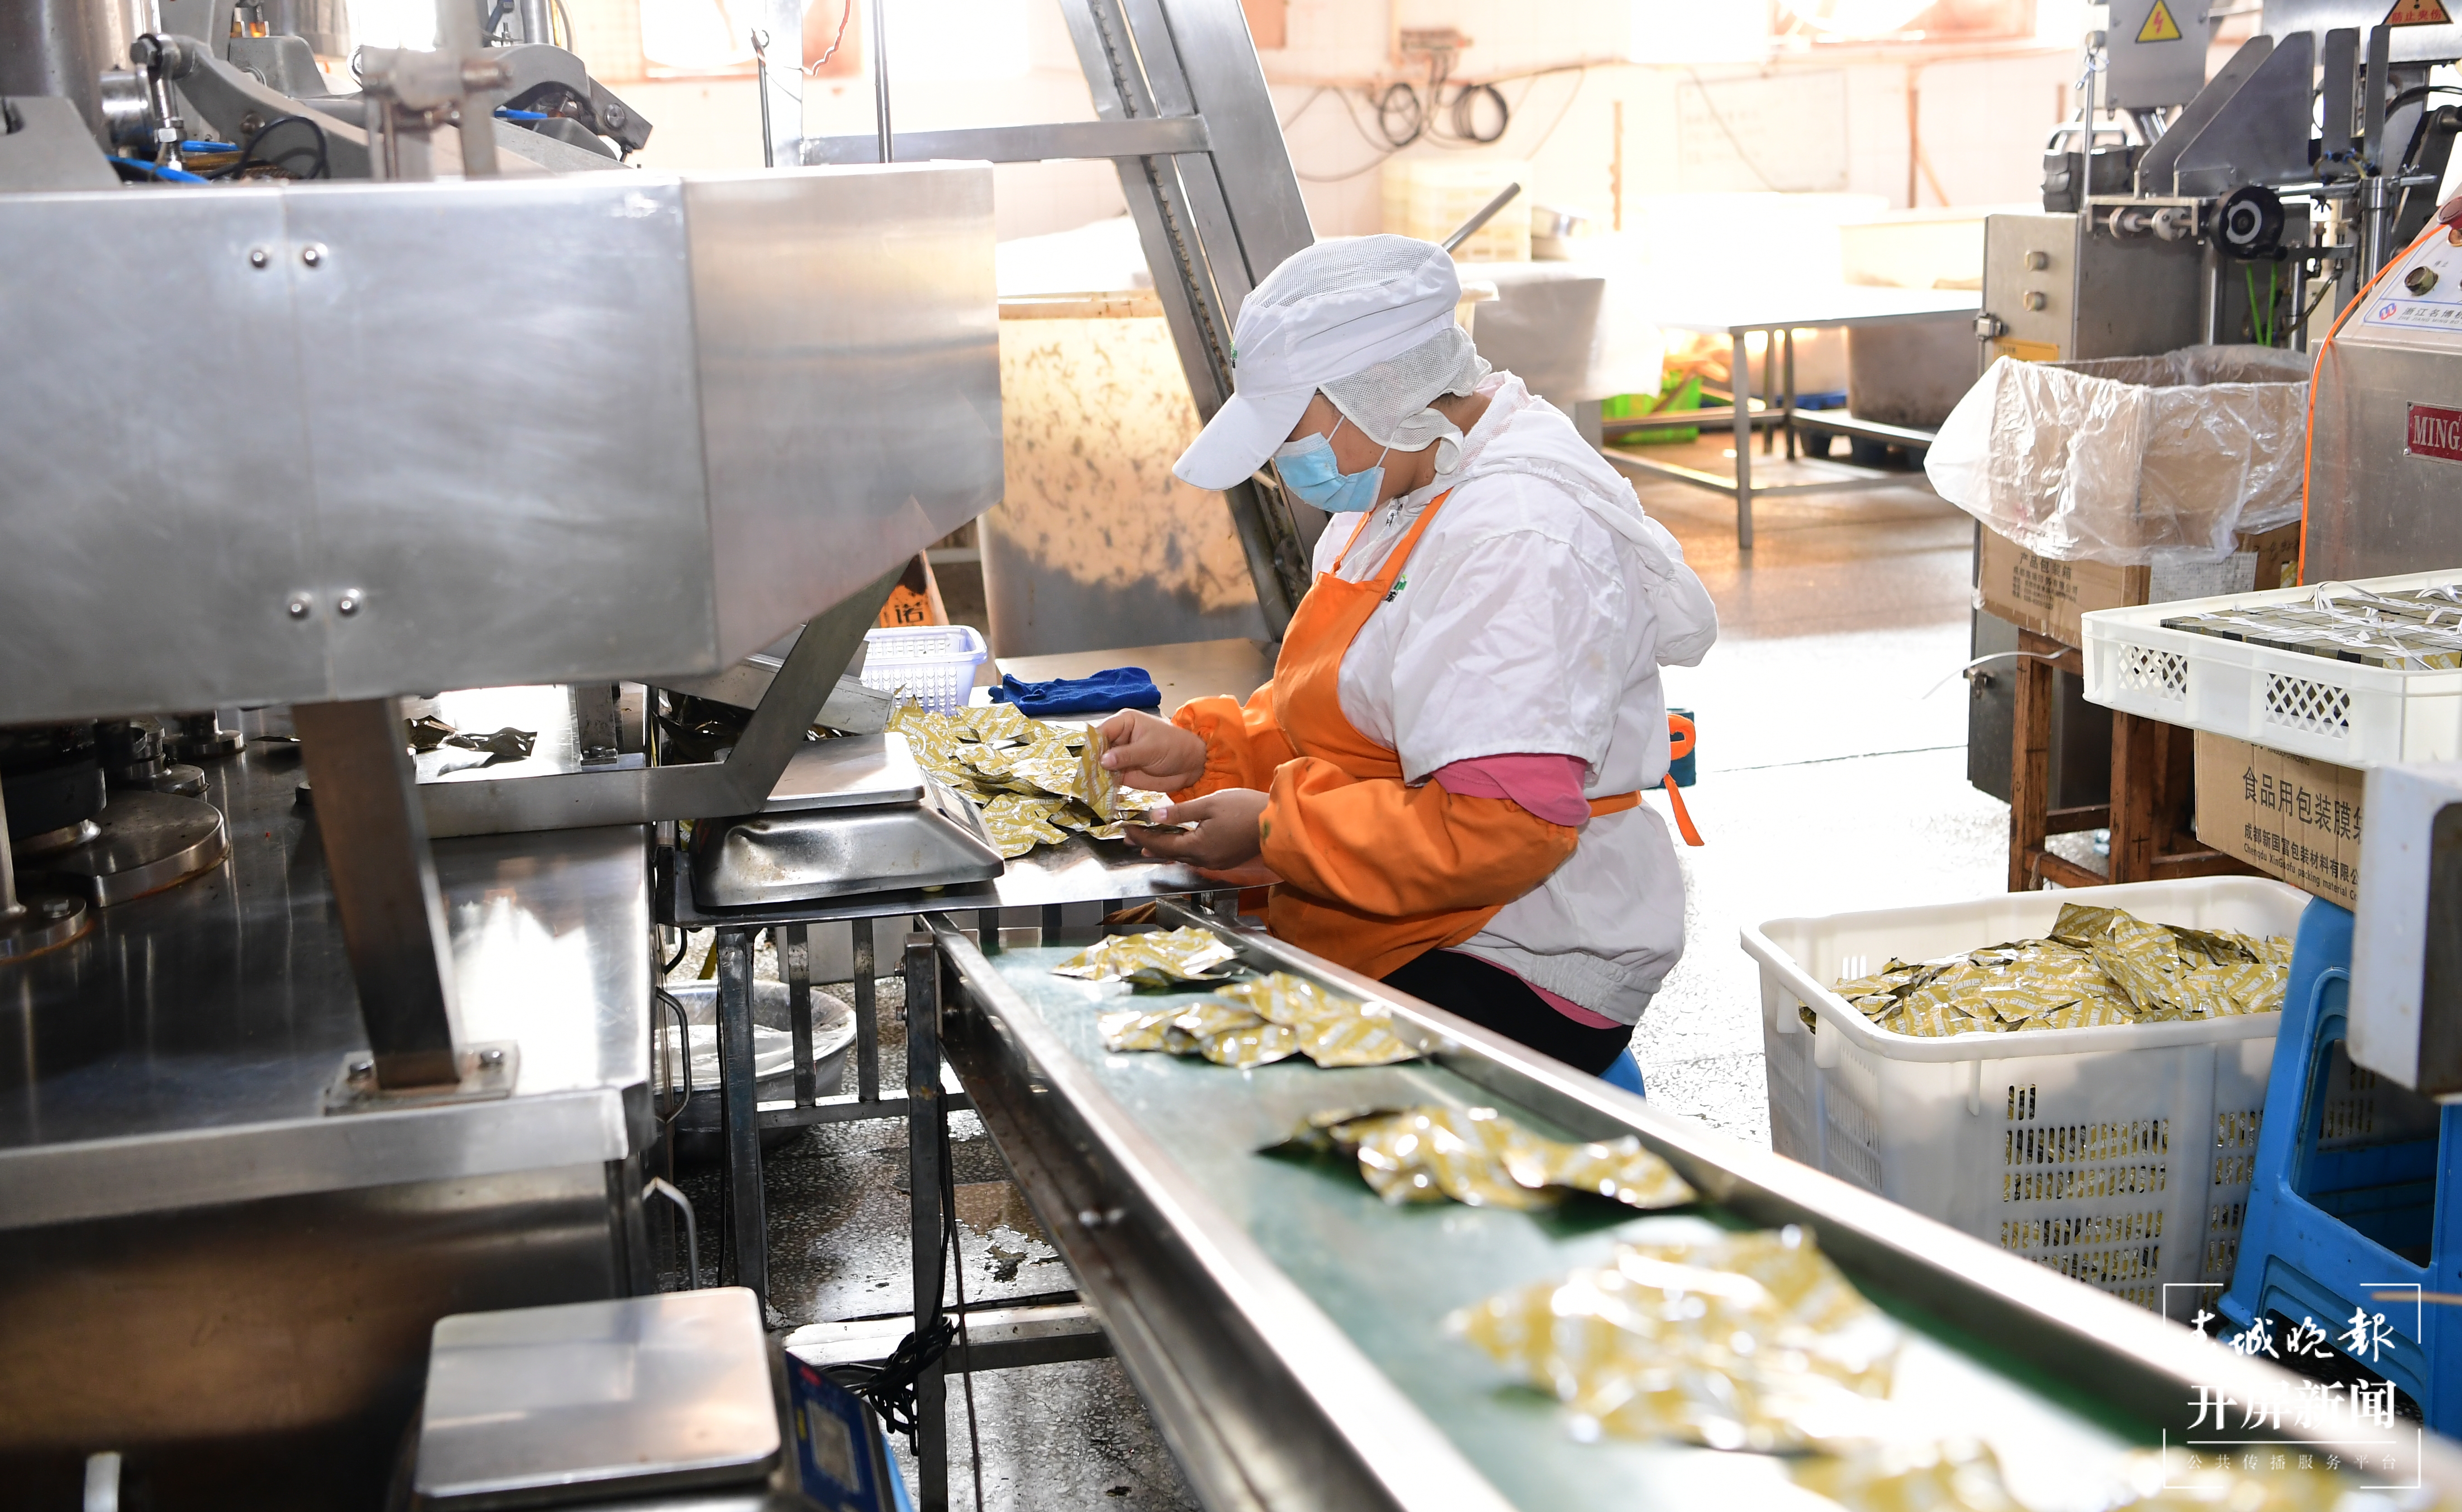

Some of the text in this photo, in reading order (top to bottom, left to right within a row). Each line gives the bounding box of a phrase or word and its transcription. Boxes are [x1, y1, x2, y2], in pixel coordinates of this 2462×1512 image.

[2412, 415, 2462, 451] MING
[2020, 552, 2071, 580] 产品包装箱
[2298, 868, 2320, 888] packing
[2323, 879, 2347, 897] material
